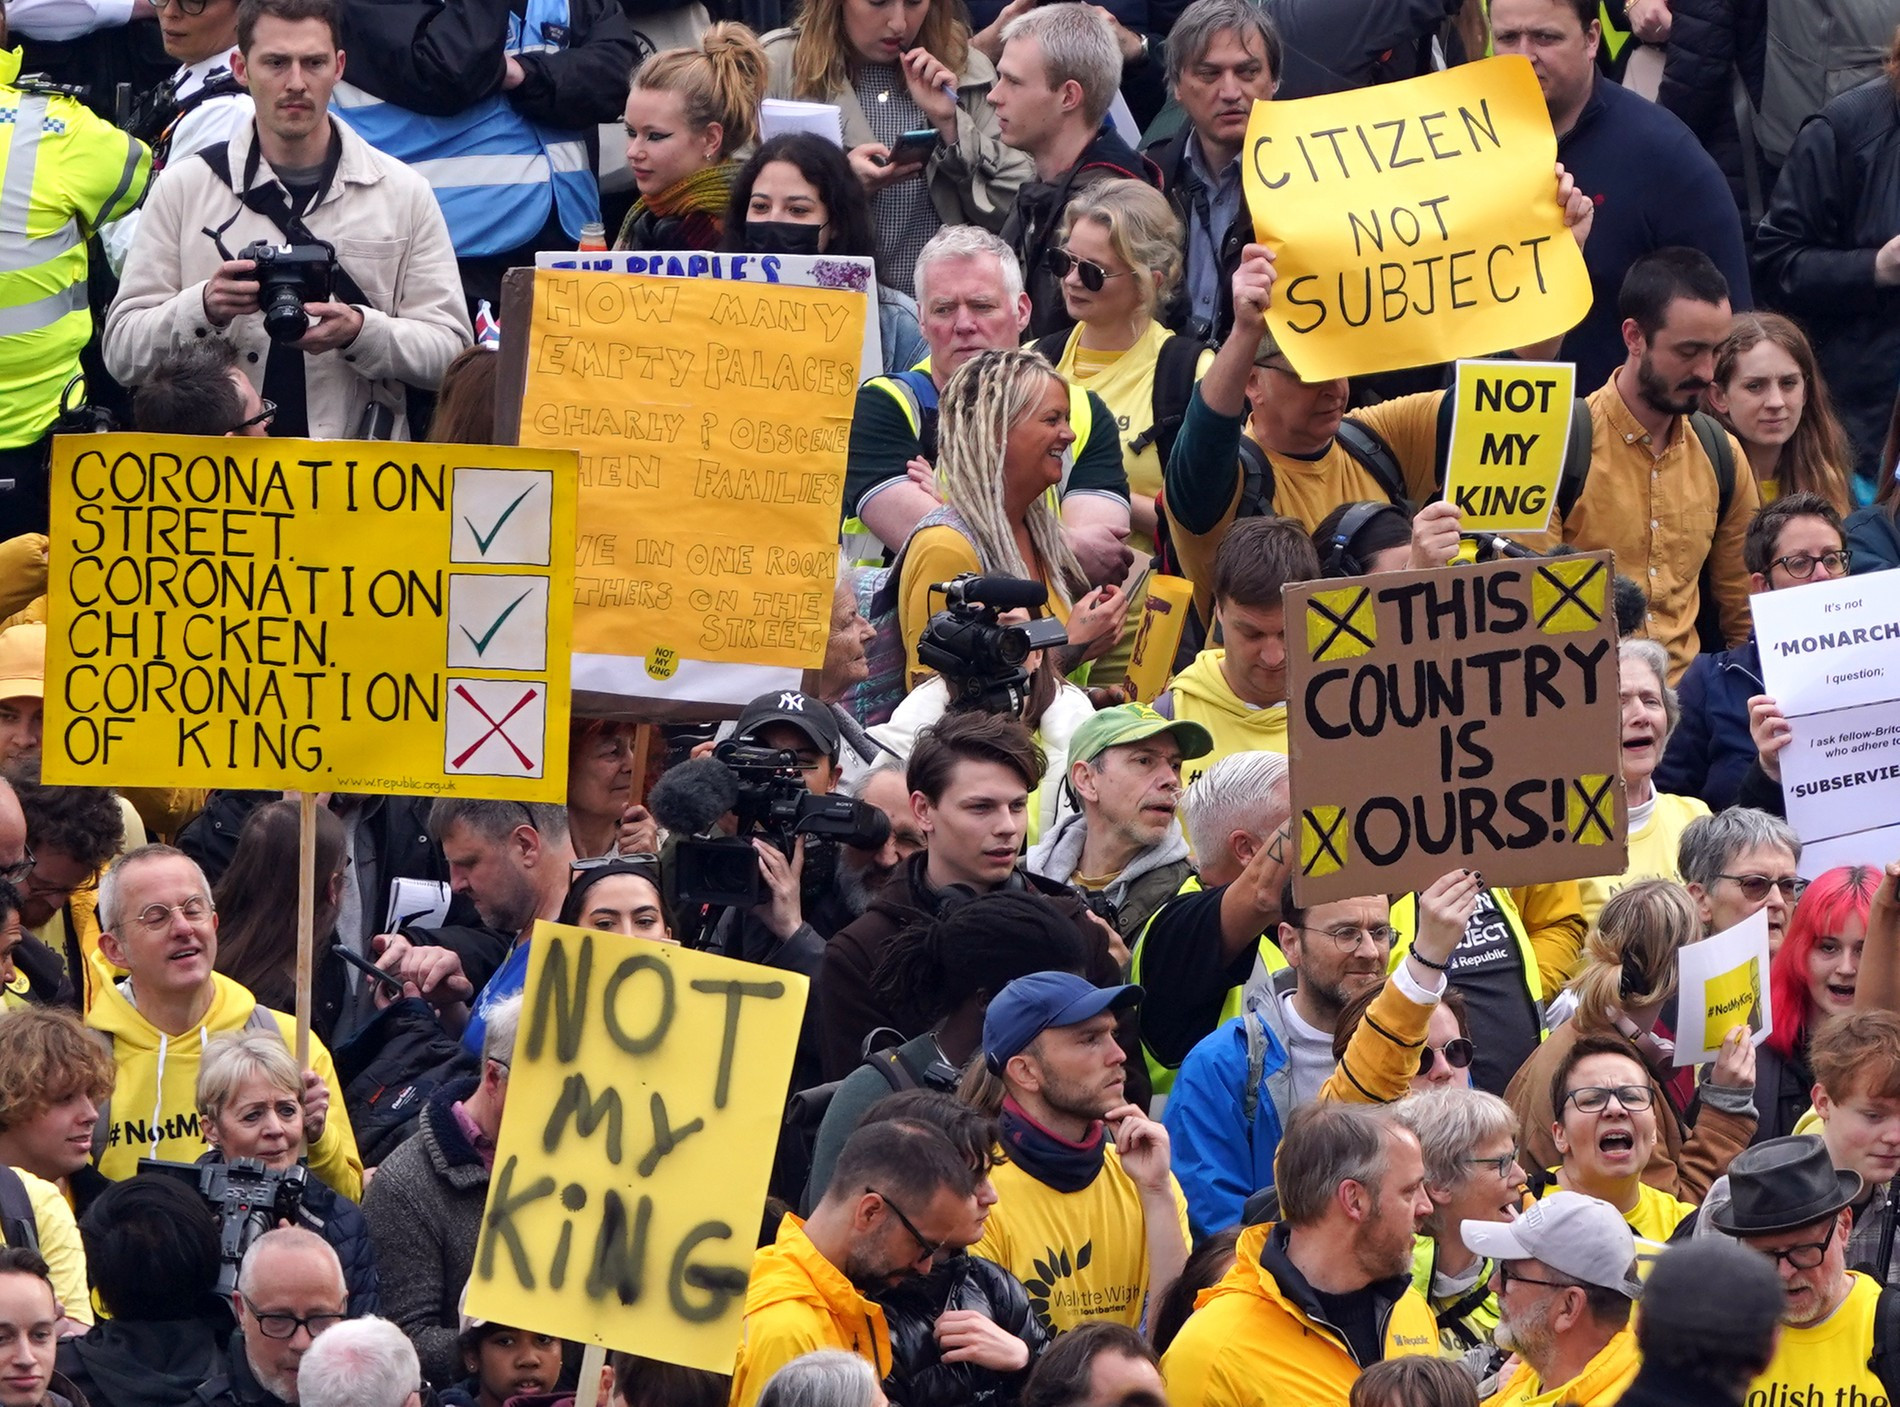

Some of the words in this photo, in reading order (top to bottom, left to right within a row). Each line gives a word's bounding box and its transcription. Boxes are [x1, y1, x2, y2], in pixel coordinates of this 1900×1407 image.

[1254, 98, 1501, 190] CITIZEN
[1348, 195, 1450, 257] NOT
[1286, 236, 1551, 334] SUBJECT
[546, 279, 680, 328] HOW
[709, 293, 850, 343] MANY
[536, 334, 695, 388] EMPTY
[704, 342, 855, 397] PALACES
[1474, 379, 1557, 413] NOT
[533, 403, 685, 443] CHARLY
[730, 417, 848, 454] OBSCENE
[1480, 433, 1541, 466] MY
[71, 450, 445, 512] CORONATION
[693, 458, 841, 506] FAMILIES
[1455, 485, 1547, 516] KING
[71, 503, 295, 563] STREET.
[635, 538, 675, 569] IN
[686, 543, 754, 577] ONE
[765, 546, 837, 580] ROOM
[69, 555, 443, 618] CORONATION
[573, 576, 673, 611] THERS
[688, 588, 739, 612] ON
[753, 592, 823, 619] THE
[1377, 571, 1528, 645] THIS
[1824, 602, 1841, 613] It's
[1844, 599, 1863, 610] not
[68, 609, 336, 668] CHICKEN.
[655, 647, 675, 658] NOT
[698, 614, 822, 653] STREET.
[647, 664, 671, 678] KING
[654, 656, 670, 667] MY
[1832, 667, 1885, 685] question;
[64, 660, 440, 723] CORONATION
[1304, 638, 1610, 739] COUNTRY
[64, 716, 136, 766] OF
[177, 717, 333, 773] KING.
[1440, 720, 1494, 782] IS
[1816, 735, 1836, 746] ask
[1825, 747, 1848, 758] who
[1851, 740, 1889, 753] adhere
[337, 775, 457, 794] www.republic.org.uk
[1353, 778, 1566, 867] OURS!
[1460, 948, 1508, 967] Republic
[526, 934, 786, 1110] NOT
[1707, 992, 1753, 1018] #NotMyKing
[542, 1071, 705, 1178] MY
[1104, 1284, 1141, 1305] Wigh
[1835, 1384, 1889, 1407] the
